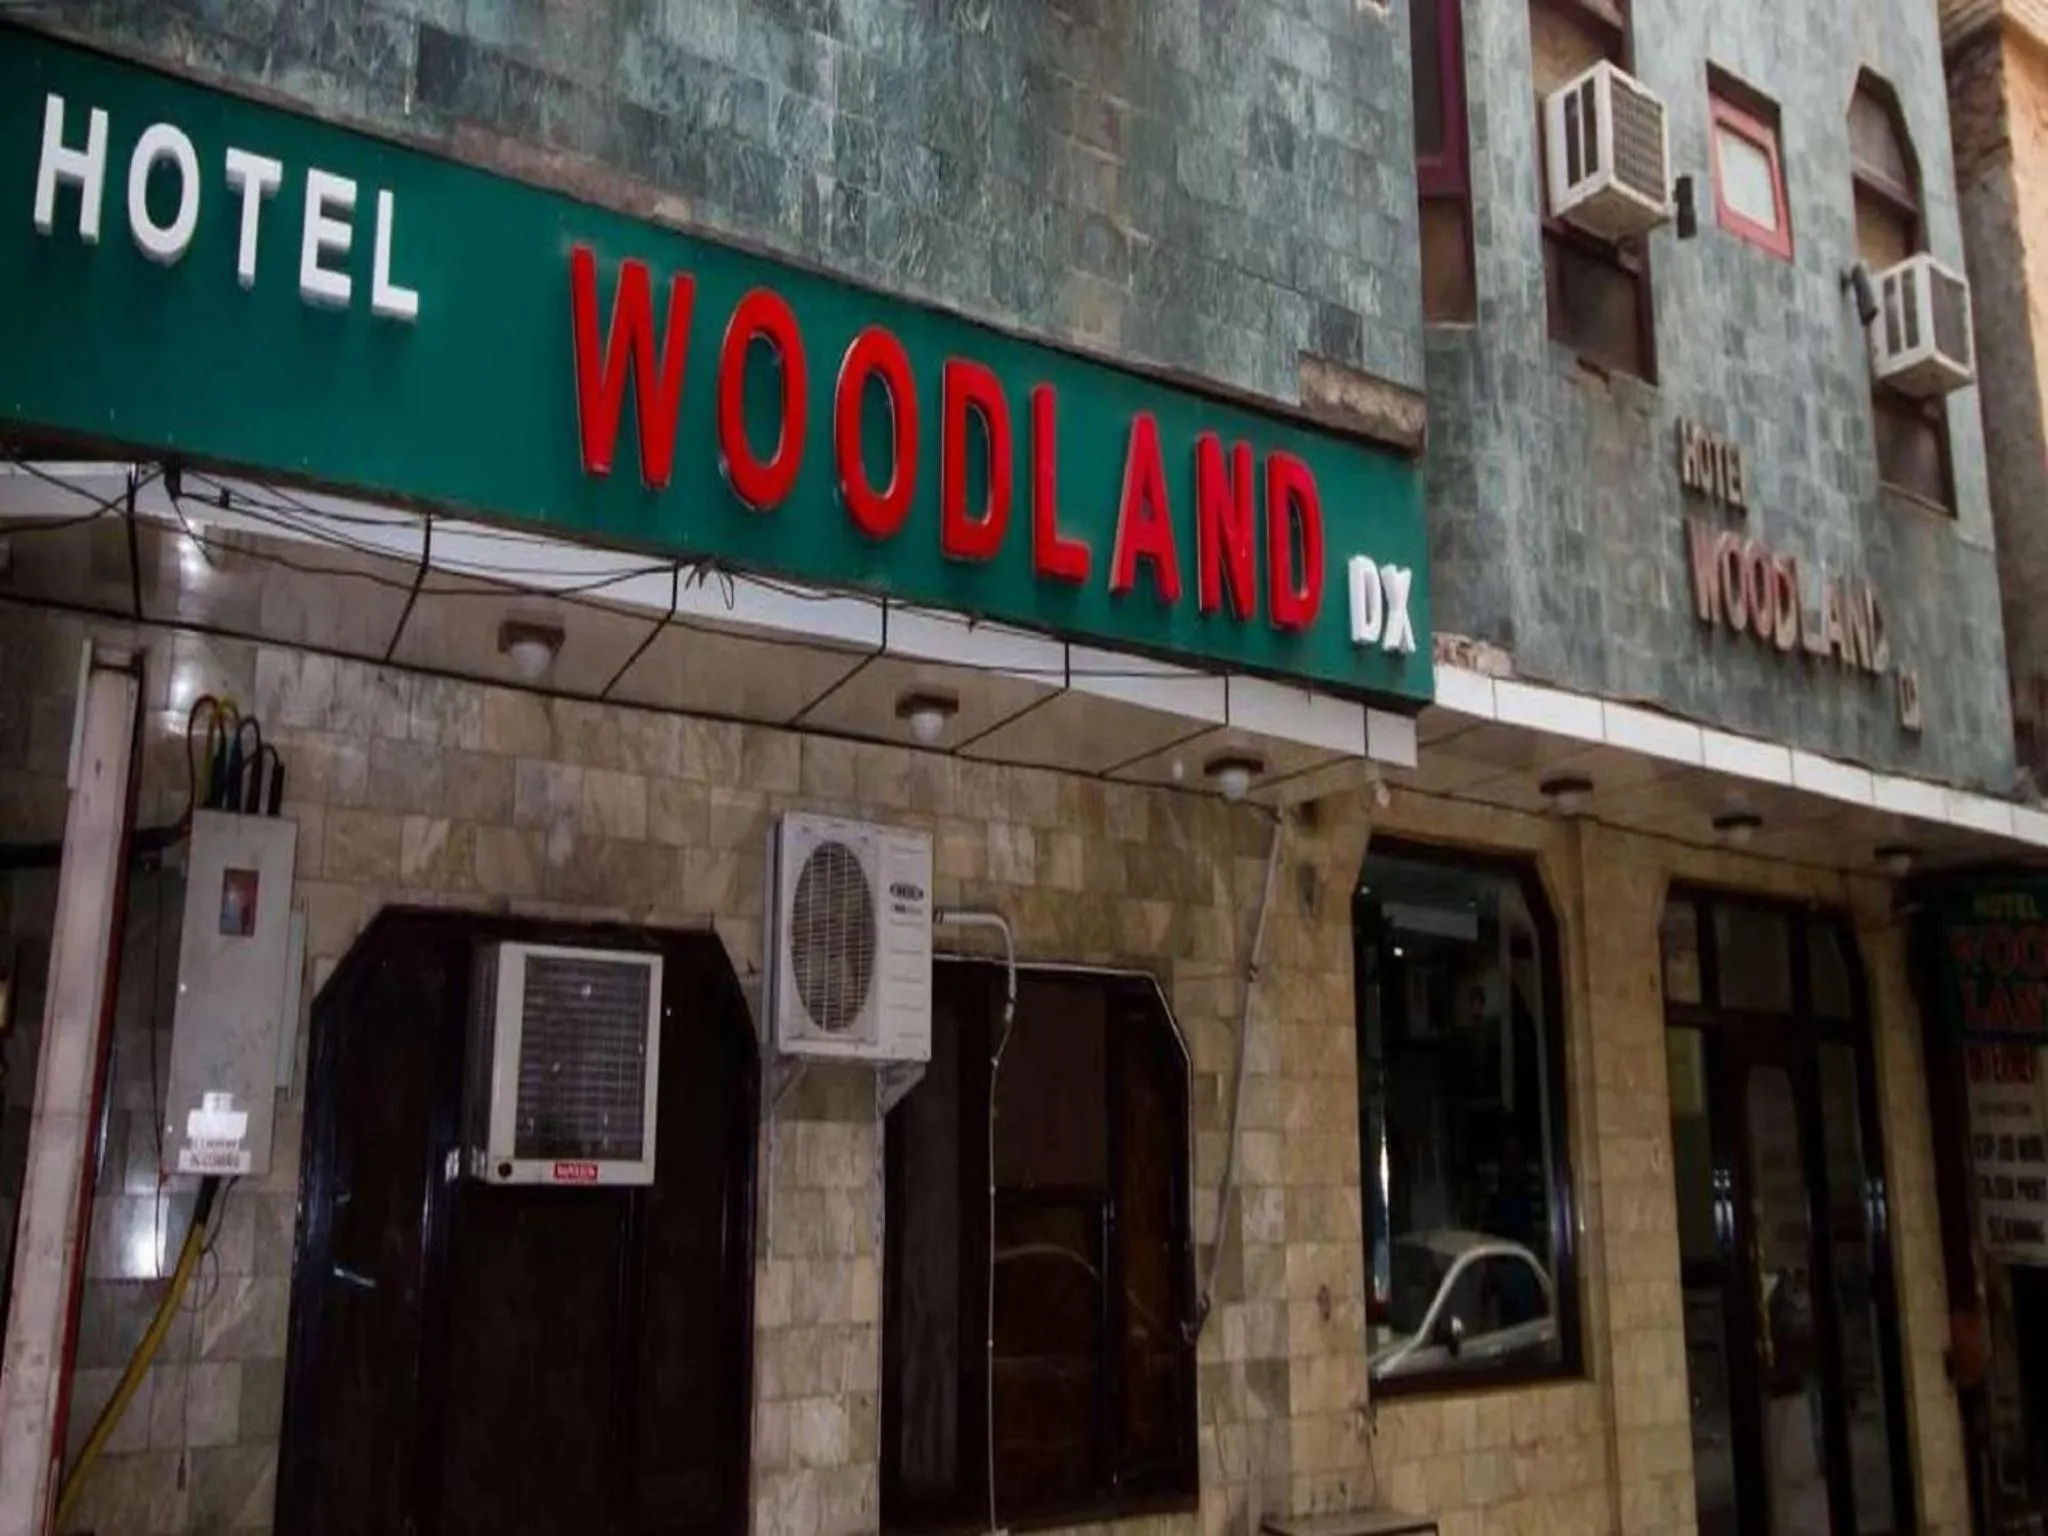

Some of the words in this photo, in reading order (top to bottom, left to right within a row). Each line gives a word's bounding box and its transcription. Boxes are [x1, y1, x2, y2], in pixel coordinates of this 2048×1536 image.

[33, 92, 419, 322] HOTEL
[571, 243, 1325, 632] WOODLAND
[1347, 554, 1415, 653] DX
[1687, 514, 1890, 674] WOODLAND
